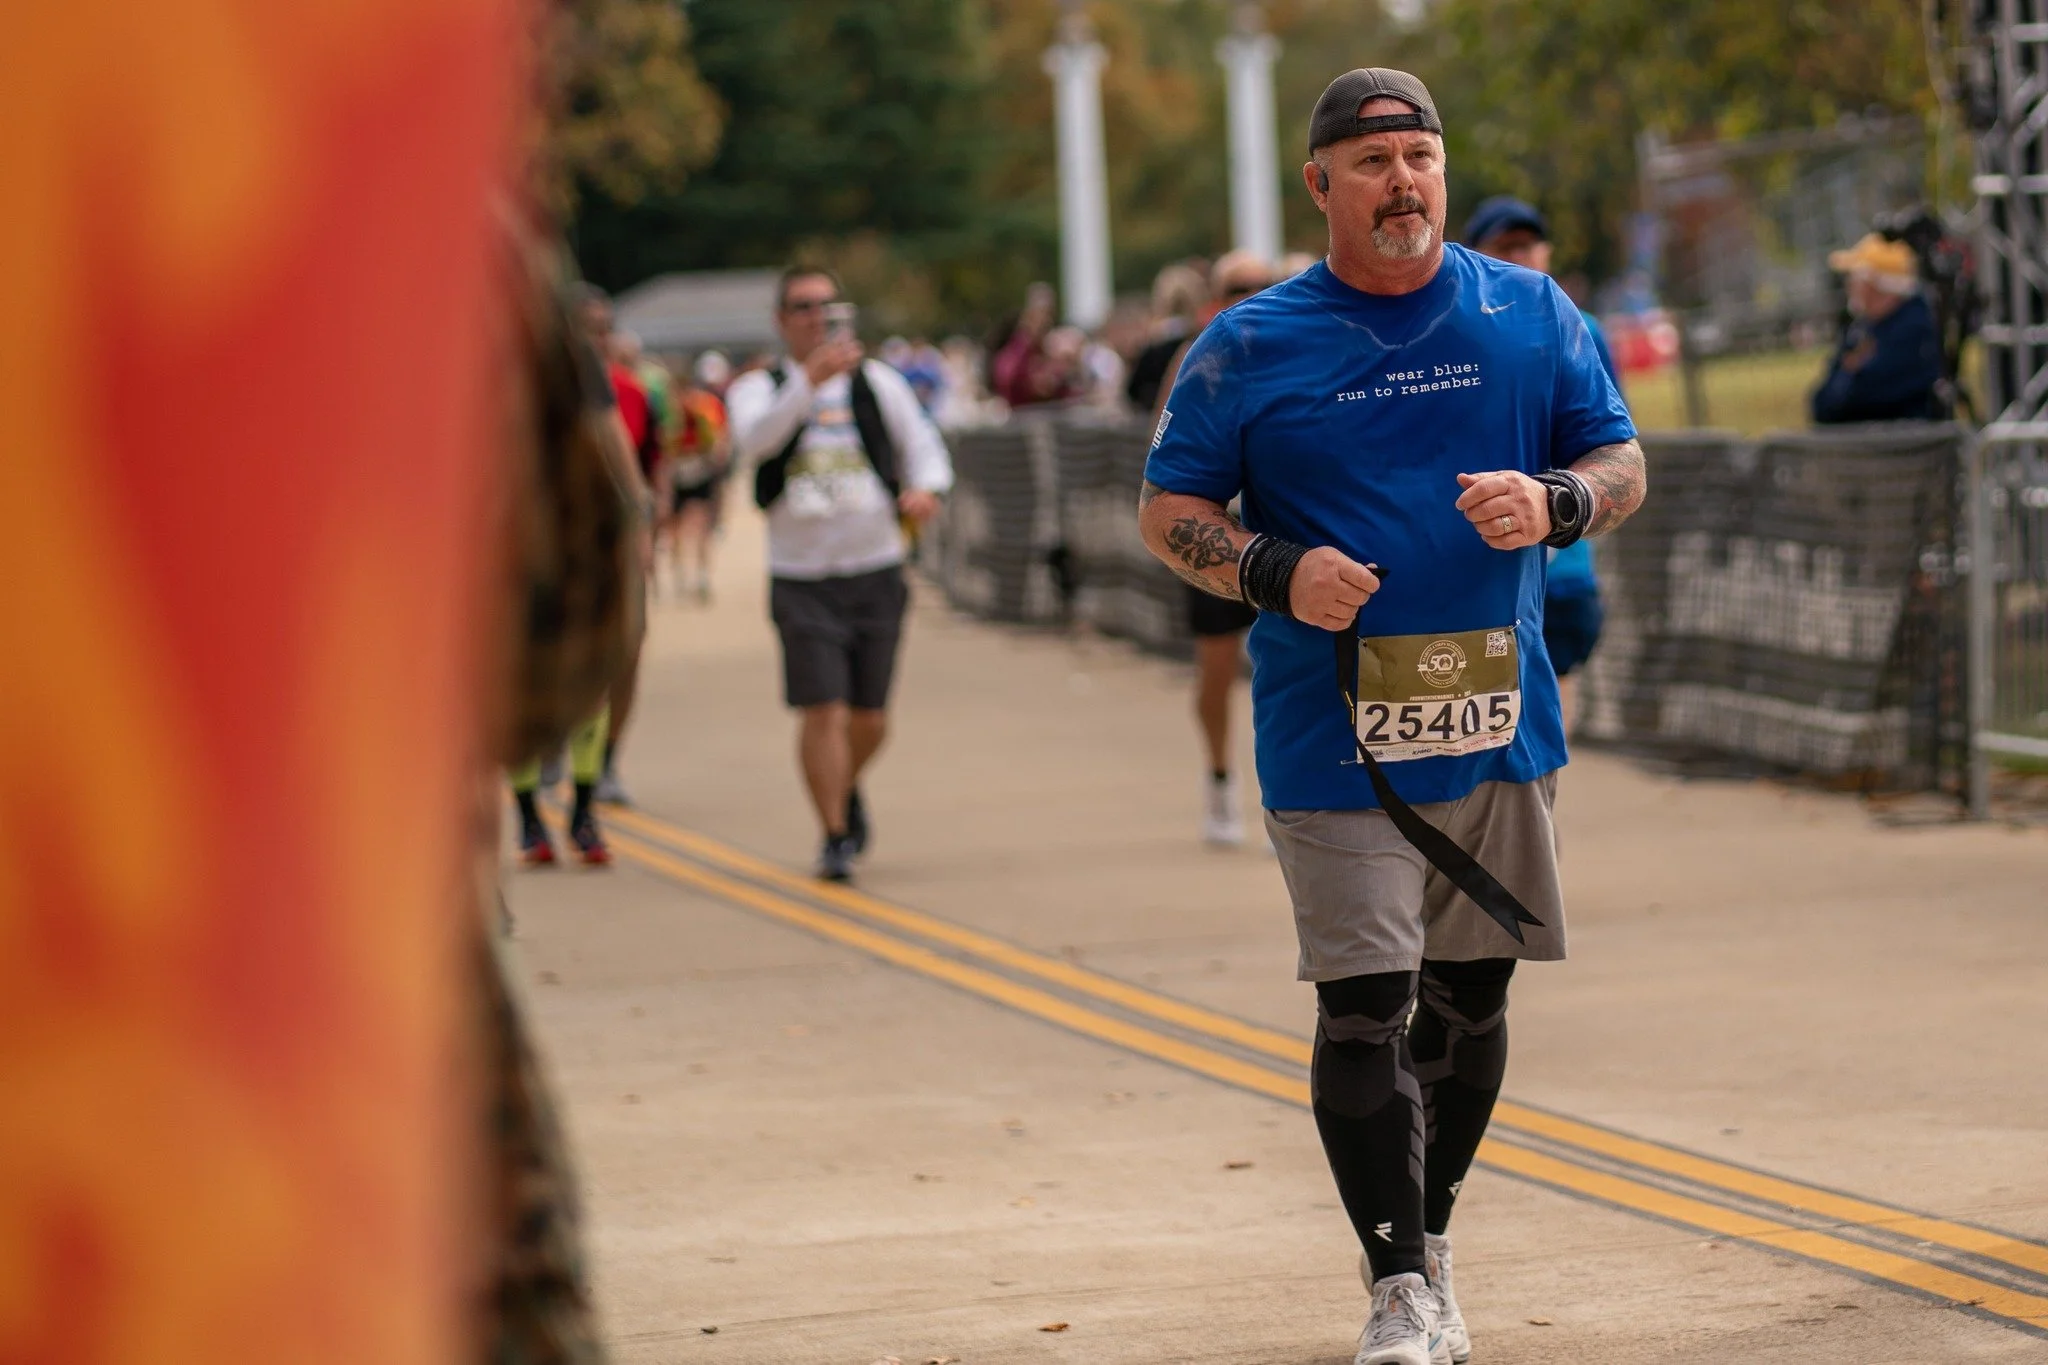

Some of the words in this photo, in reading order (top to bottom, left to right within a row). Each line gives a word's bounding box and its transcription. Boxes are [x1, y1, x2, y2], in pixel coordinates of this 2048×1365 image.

[1386, 369, 1425, 382] wear
[1434, 363, 1479, 377] blue:
[1337, 390, 1367, 402] run
[1375, 386, 1393, 398] to
[1364, 695, 1512, 743] 25405
